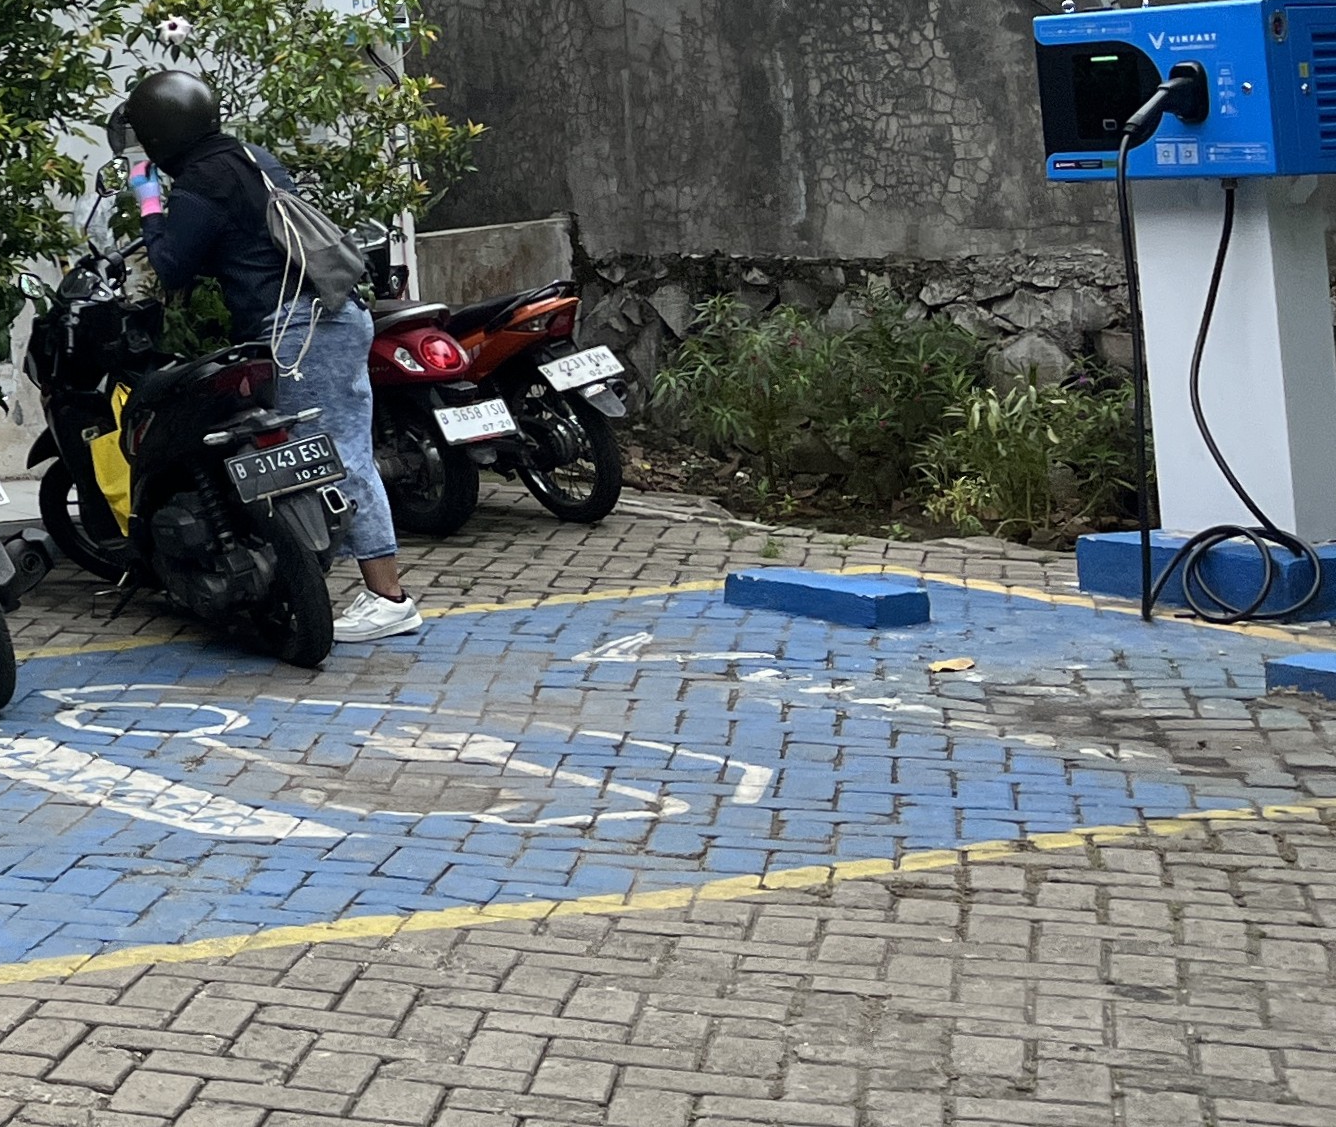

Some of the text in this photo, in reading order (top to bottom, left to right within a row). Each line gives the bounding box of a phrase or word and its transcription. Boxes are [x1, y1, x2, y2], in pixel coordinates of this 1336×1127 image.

[1168, 33, 1217, 44] VINFAST
[541, 366, 553, 378] B
[439, 412, 450, 426] B
[452, 406, 484, 423] 5658
[234, 441, 329, 480] B 3143 ESL
